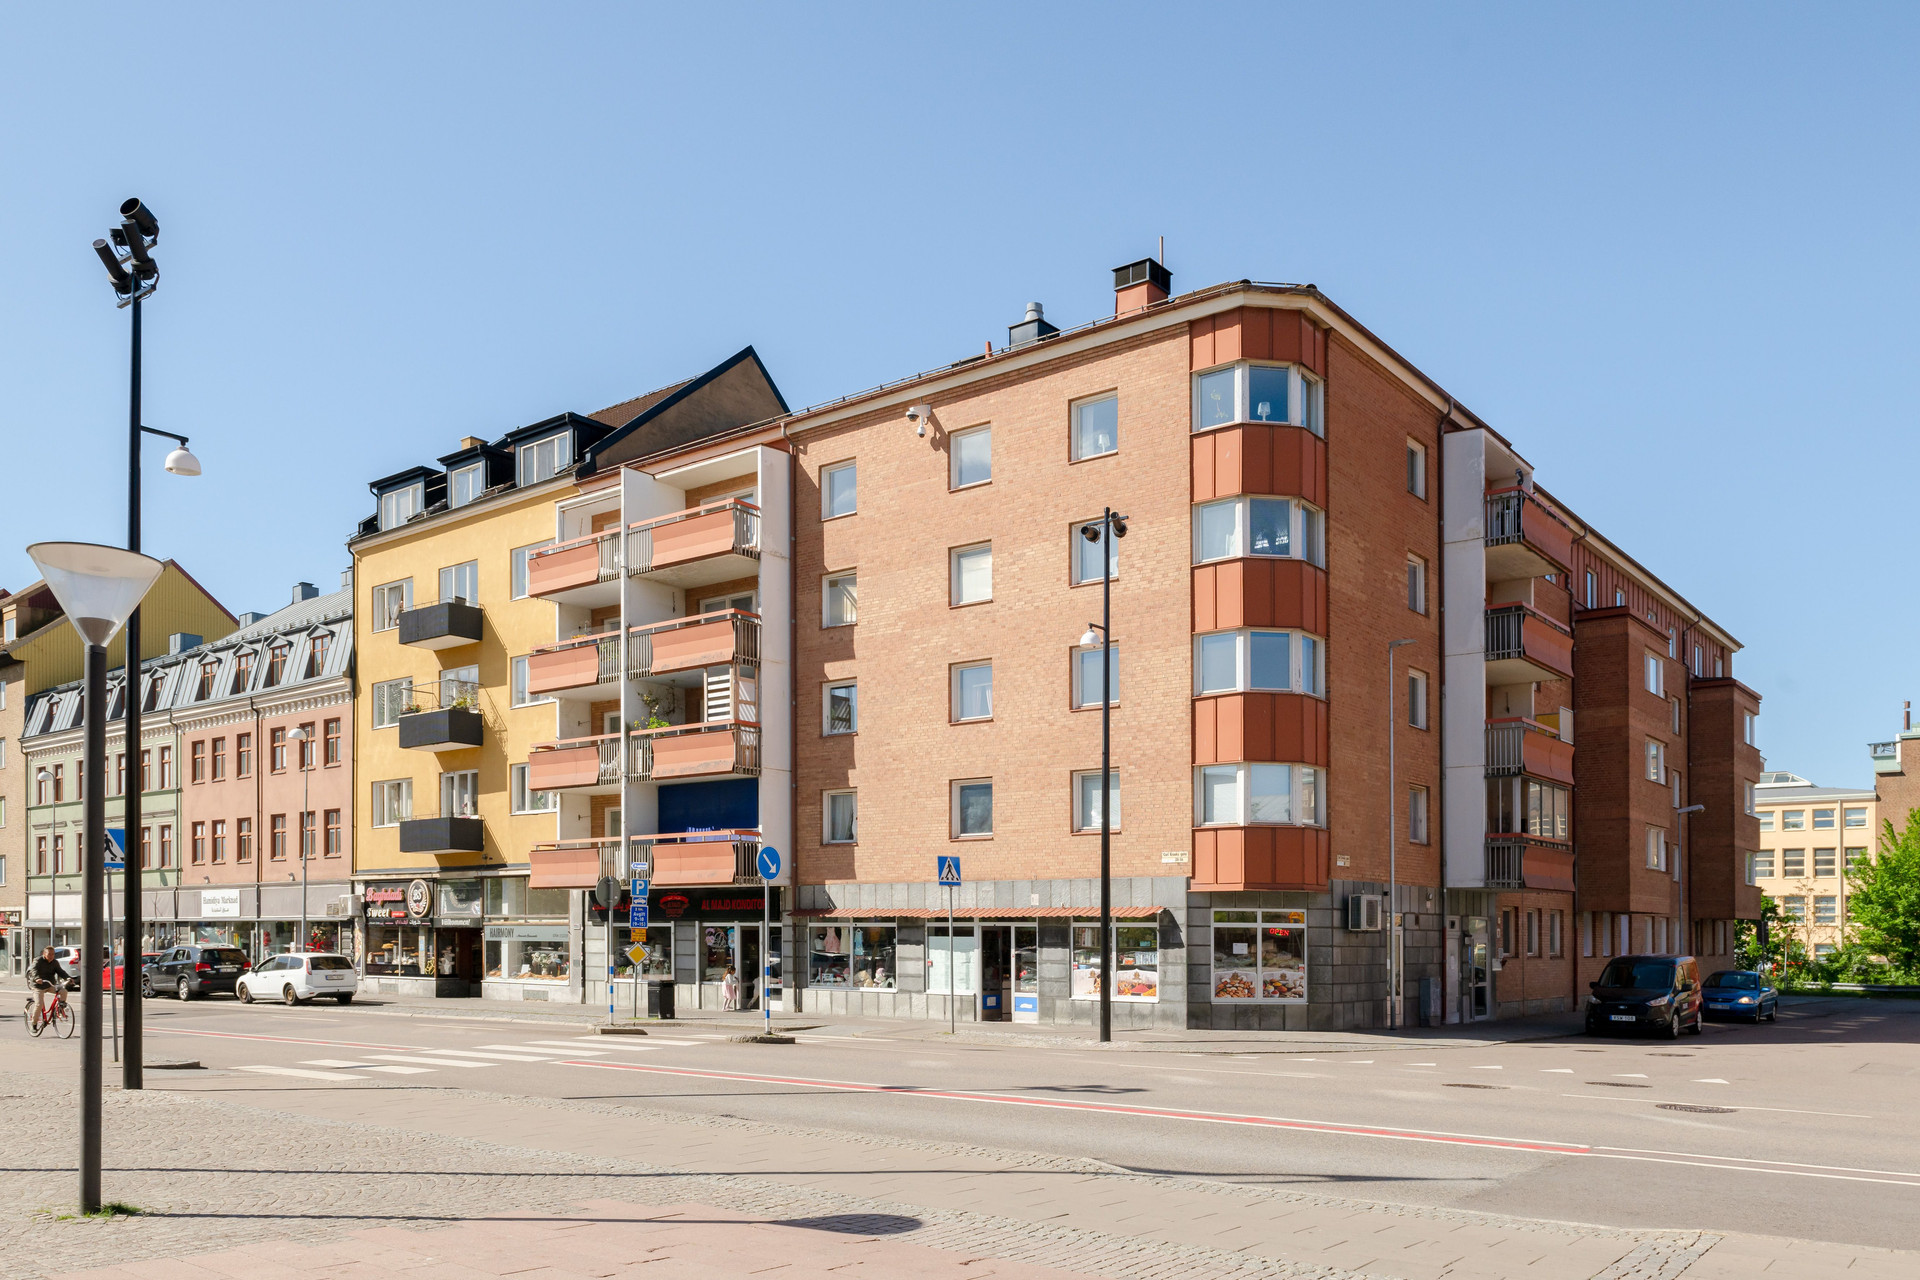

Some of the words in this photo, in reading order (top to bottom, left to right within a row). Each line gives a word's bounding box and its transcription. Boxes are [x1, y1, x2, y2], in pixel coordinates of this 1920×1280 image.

[636, 881, 645, 895] P
[701, 899, 710, 910] AL
[711, 899, 731, 910] MAJD
[732, 898, 765, 910] KONDITOR
[366, 907, 389, 917] Sweet
[489, 928, 515, 938] HAIRMONY
[1269, 928, 1290, 936] OPEN
